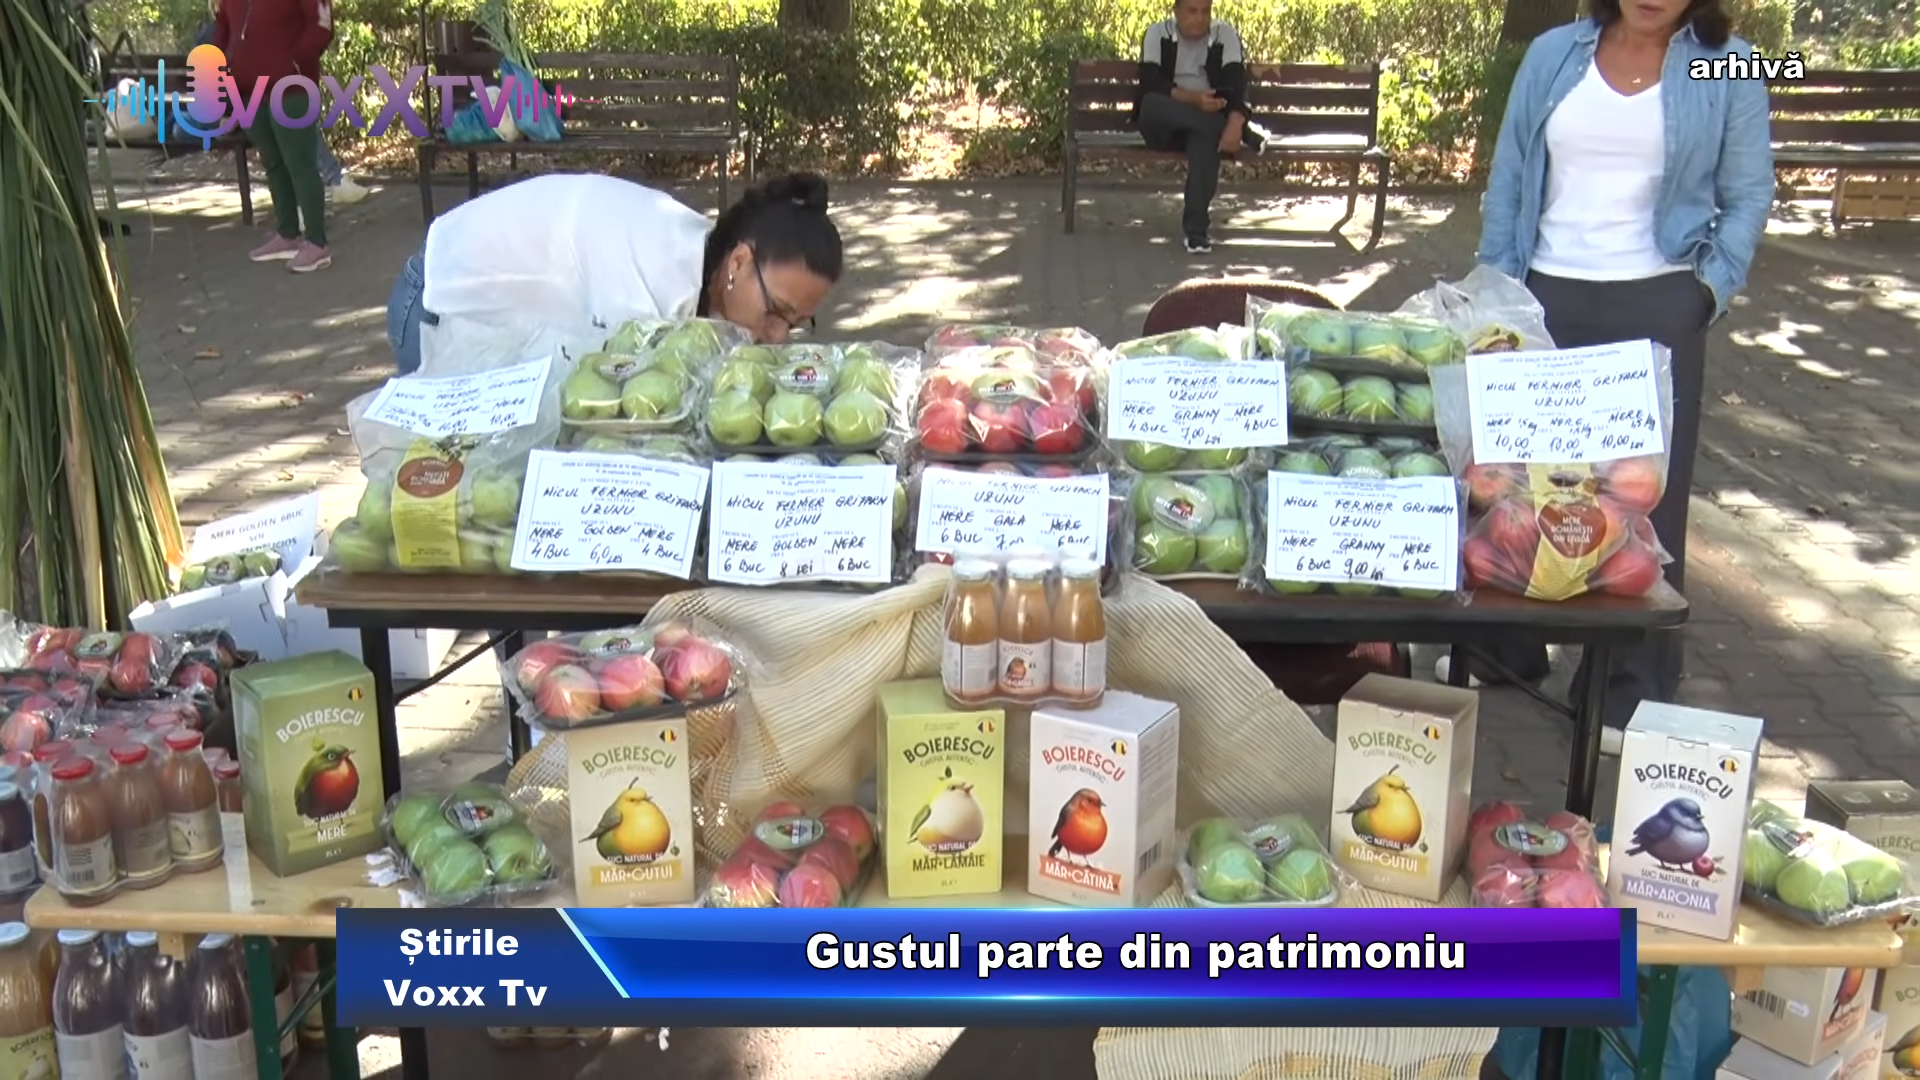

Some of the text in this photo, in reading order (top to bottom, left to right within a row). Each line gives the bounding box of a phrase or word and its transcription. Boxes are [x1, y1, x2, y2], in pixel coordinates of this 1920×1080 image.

[1139, 420, 1169, 434] BUC
[1251, 417, 1279, 432] BUC
[1173, 407, 1221, 424] GRANNY
[1495, 433, 1529, 453] 10,00
[1600, 434, 1630, 450] 10,00
[584, 524, 632, 536] GOLDEN
[993, 514, 1027, 527] GALA
[940, 527, 949, 544] 6
[953, 528, 983, 544] BUC
[530, 541, 542, 559] 4
[641, 542, 651, 556] 4
[654, 543, 684, 562] BUC
[1338, 538, 1386, 559] GRANNY
[723, 557, 732, 573] 6
[738, 557, 766, 574] BUC
[779, 561, 789, 578] 8
[837, 556, 846, 571] 6
[847, 556, 872, 571] BUC
[1296, 555, 1304, 571] 6
[1307, 558, 1331, 571] BUC
[1343, 558, 1369, 580] 9,00
[1402, 559, 1410, 571] 6
[1412, 557, 1440, 571] BUC
[276, 707, 365, 743] BOIERESCU
[903, 736, 995, 764] BOIERESCU
[1348, 731, 1437, 765] BOIERESCU
[582, 746, 677, 774] BOIERESCU
[1042, 745, 1125, 782] BOIERESCU
[1634, 763, 1733, 799] BOIERESCU
[317, 823, 347, 844] MERE
[1373, 836, 1401, 850] NATURAL
[938, 841, 966, 851] NATURAL
[624, 854, 653, 863] NATURAL
[1658, 871, 1689, 887] NATURAL
